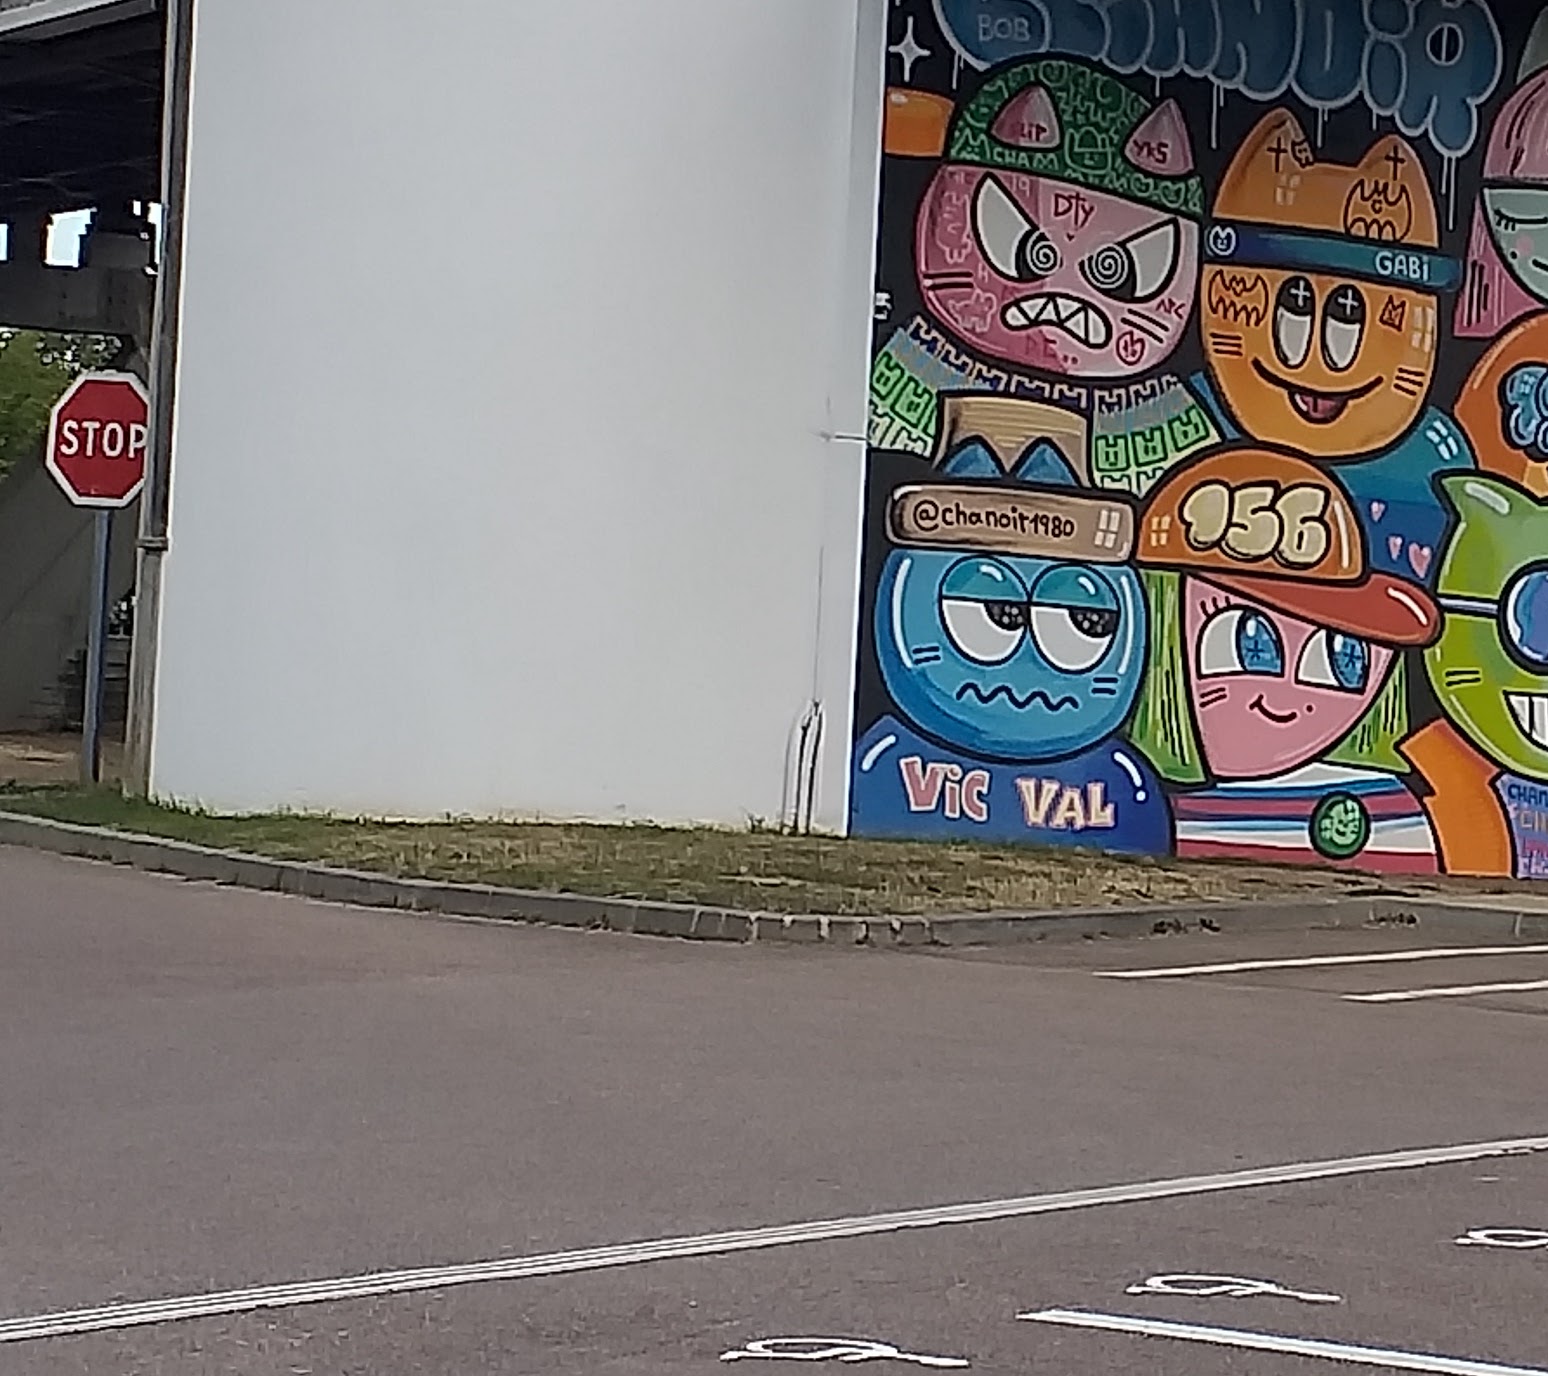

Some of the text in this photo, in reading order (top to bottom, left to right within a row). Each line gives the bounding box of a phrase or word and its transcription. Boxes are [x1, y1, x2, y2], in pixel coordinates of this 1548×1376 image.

[978, 14, 1031, 43] BOB
[60, 420, 147, 459] STOP
[1181, 479, 1329, 570] 156
[1015, 775, 1117, 830] VAL
